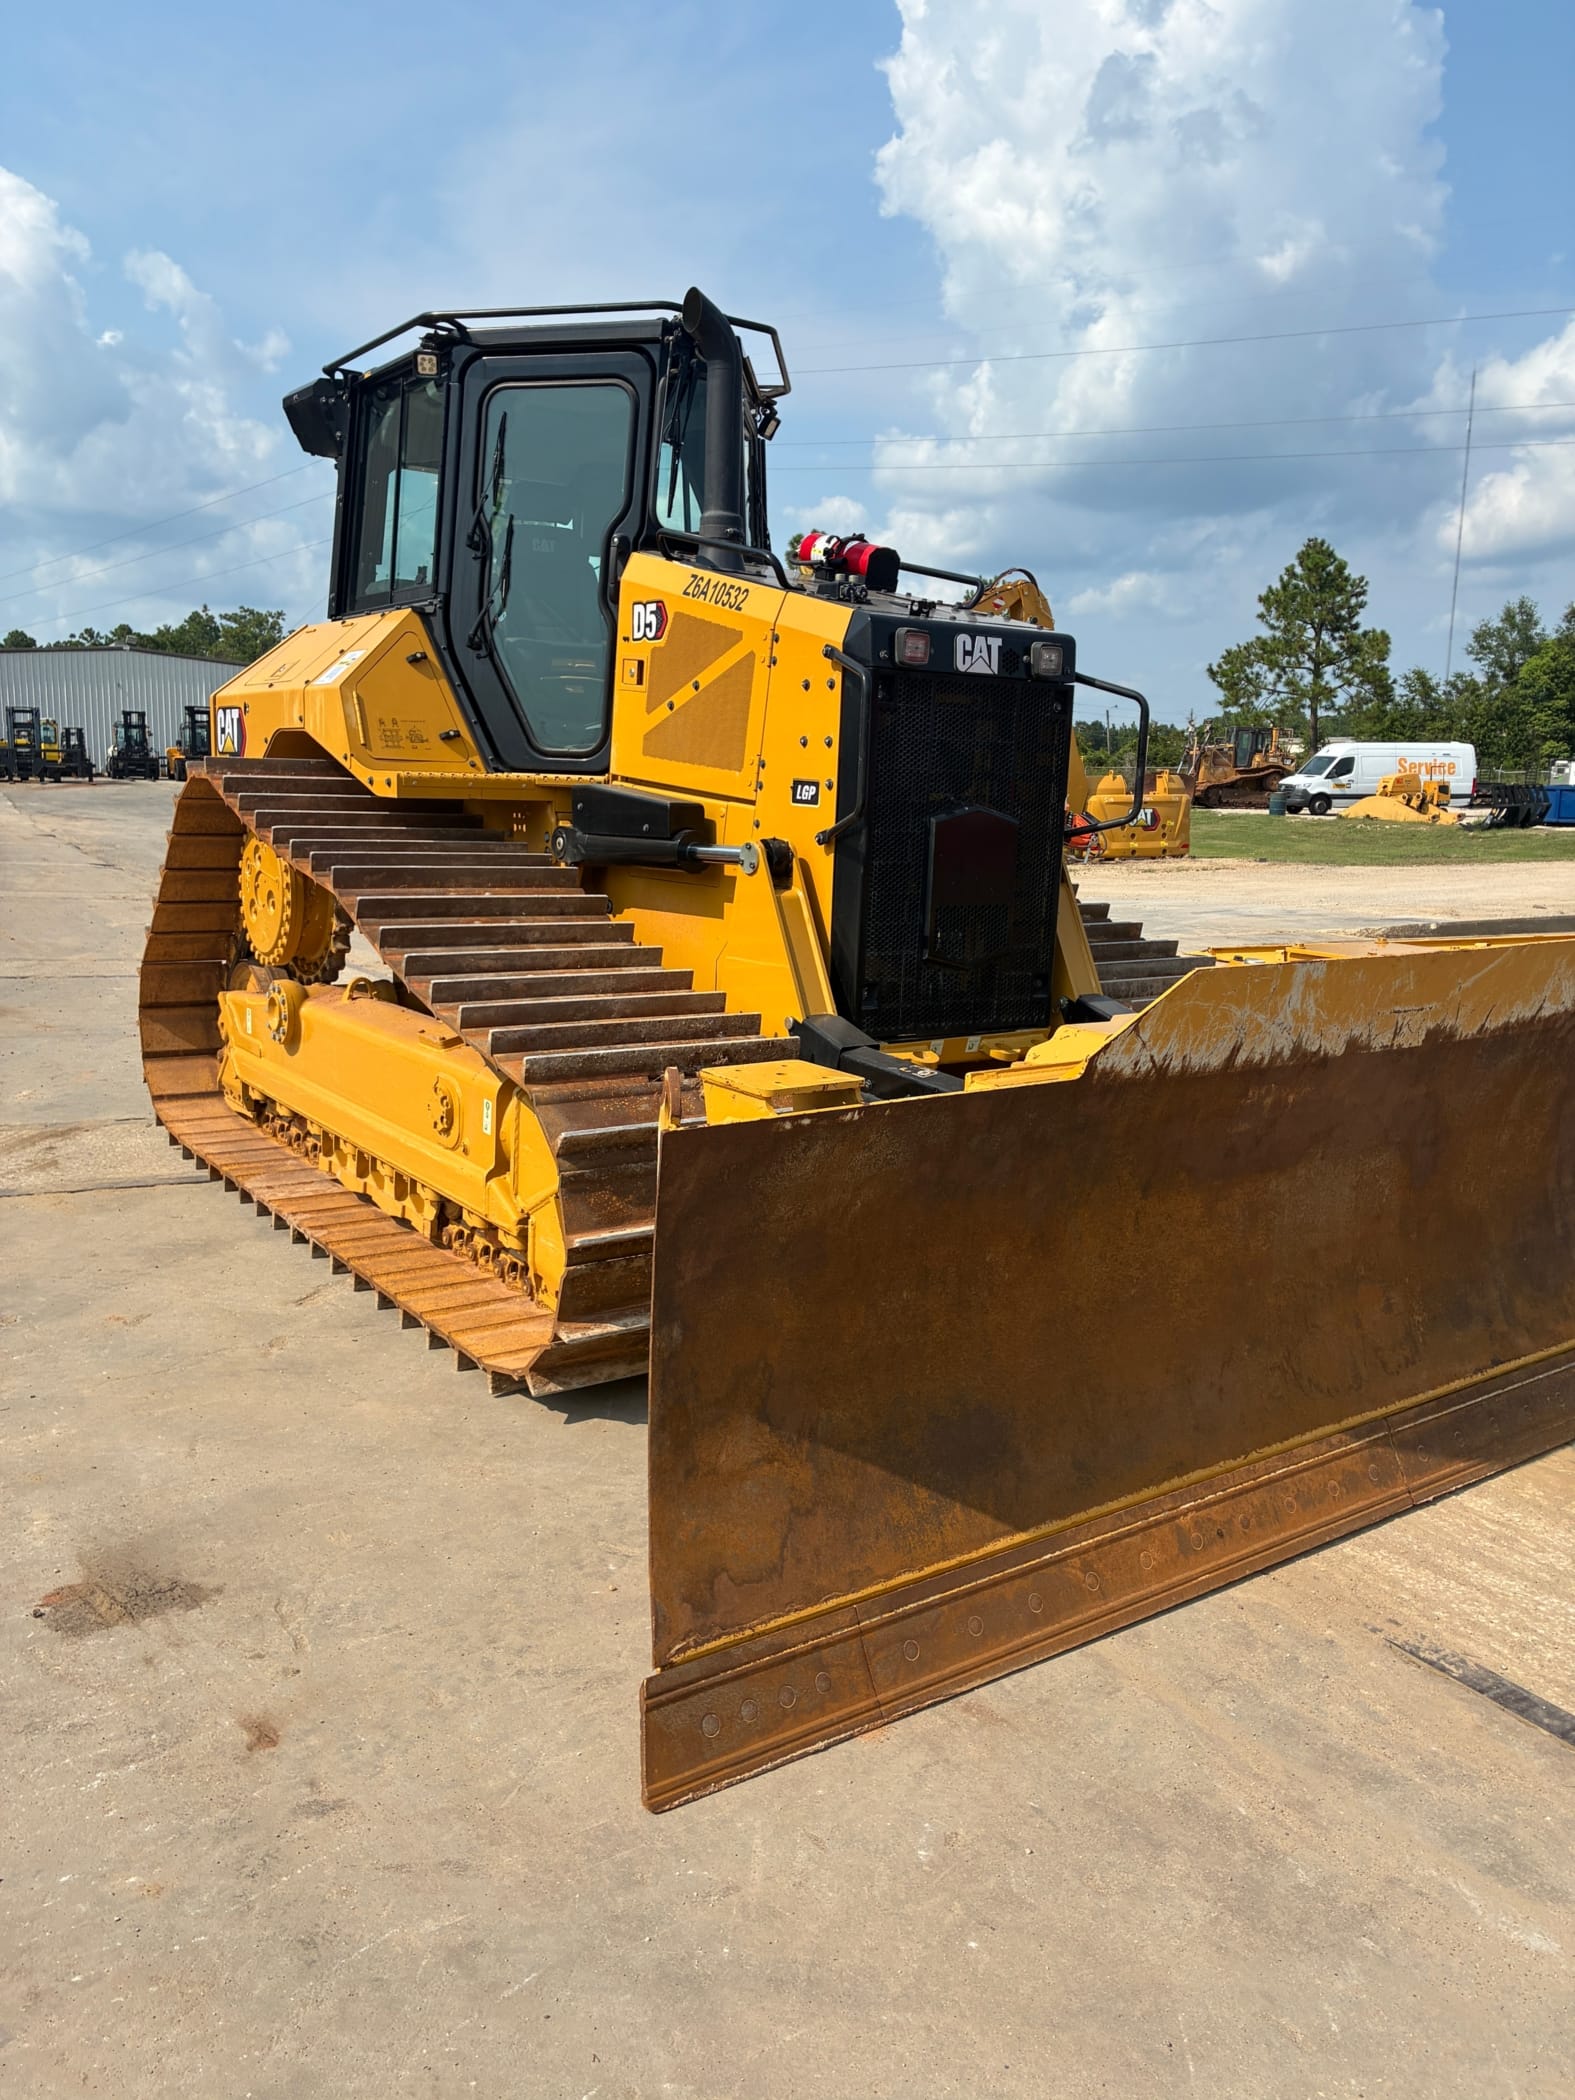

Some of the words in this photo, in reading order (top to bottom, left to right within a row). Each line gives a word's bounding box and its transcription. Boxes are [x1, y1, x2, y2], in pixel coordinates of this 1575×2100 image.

[682, 573, 750, 611] Z6A10532
[633, 602, 657, 639] D5
[956, 633, 1003, 675] CAT
[217, 708, 239, 752] CAT
[1398, 757, 1456, 776] Service
[796, 784, 817, 801] LGP
